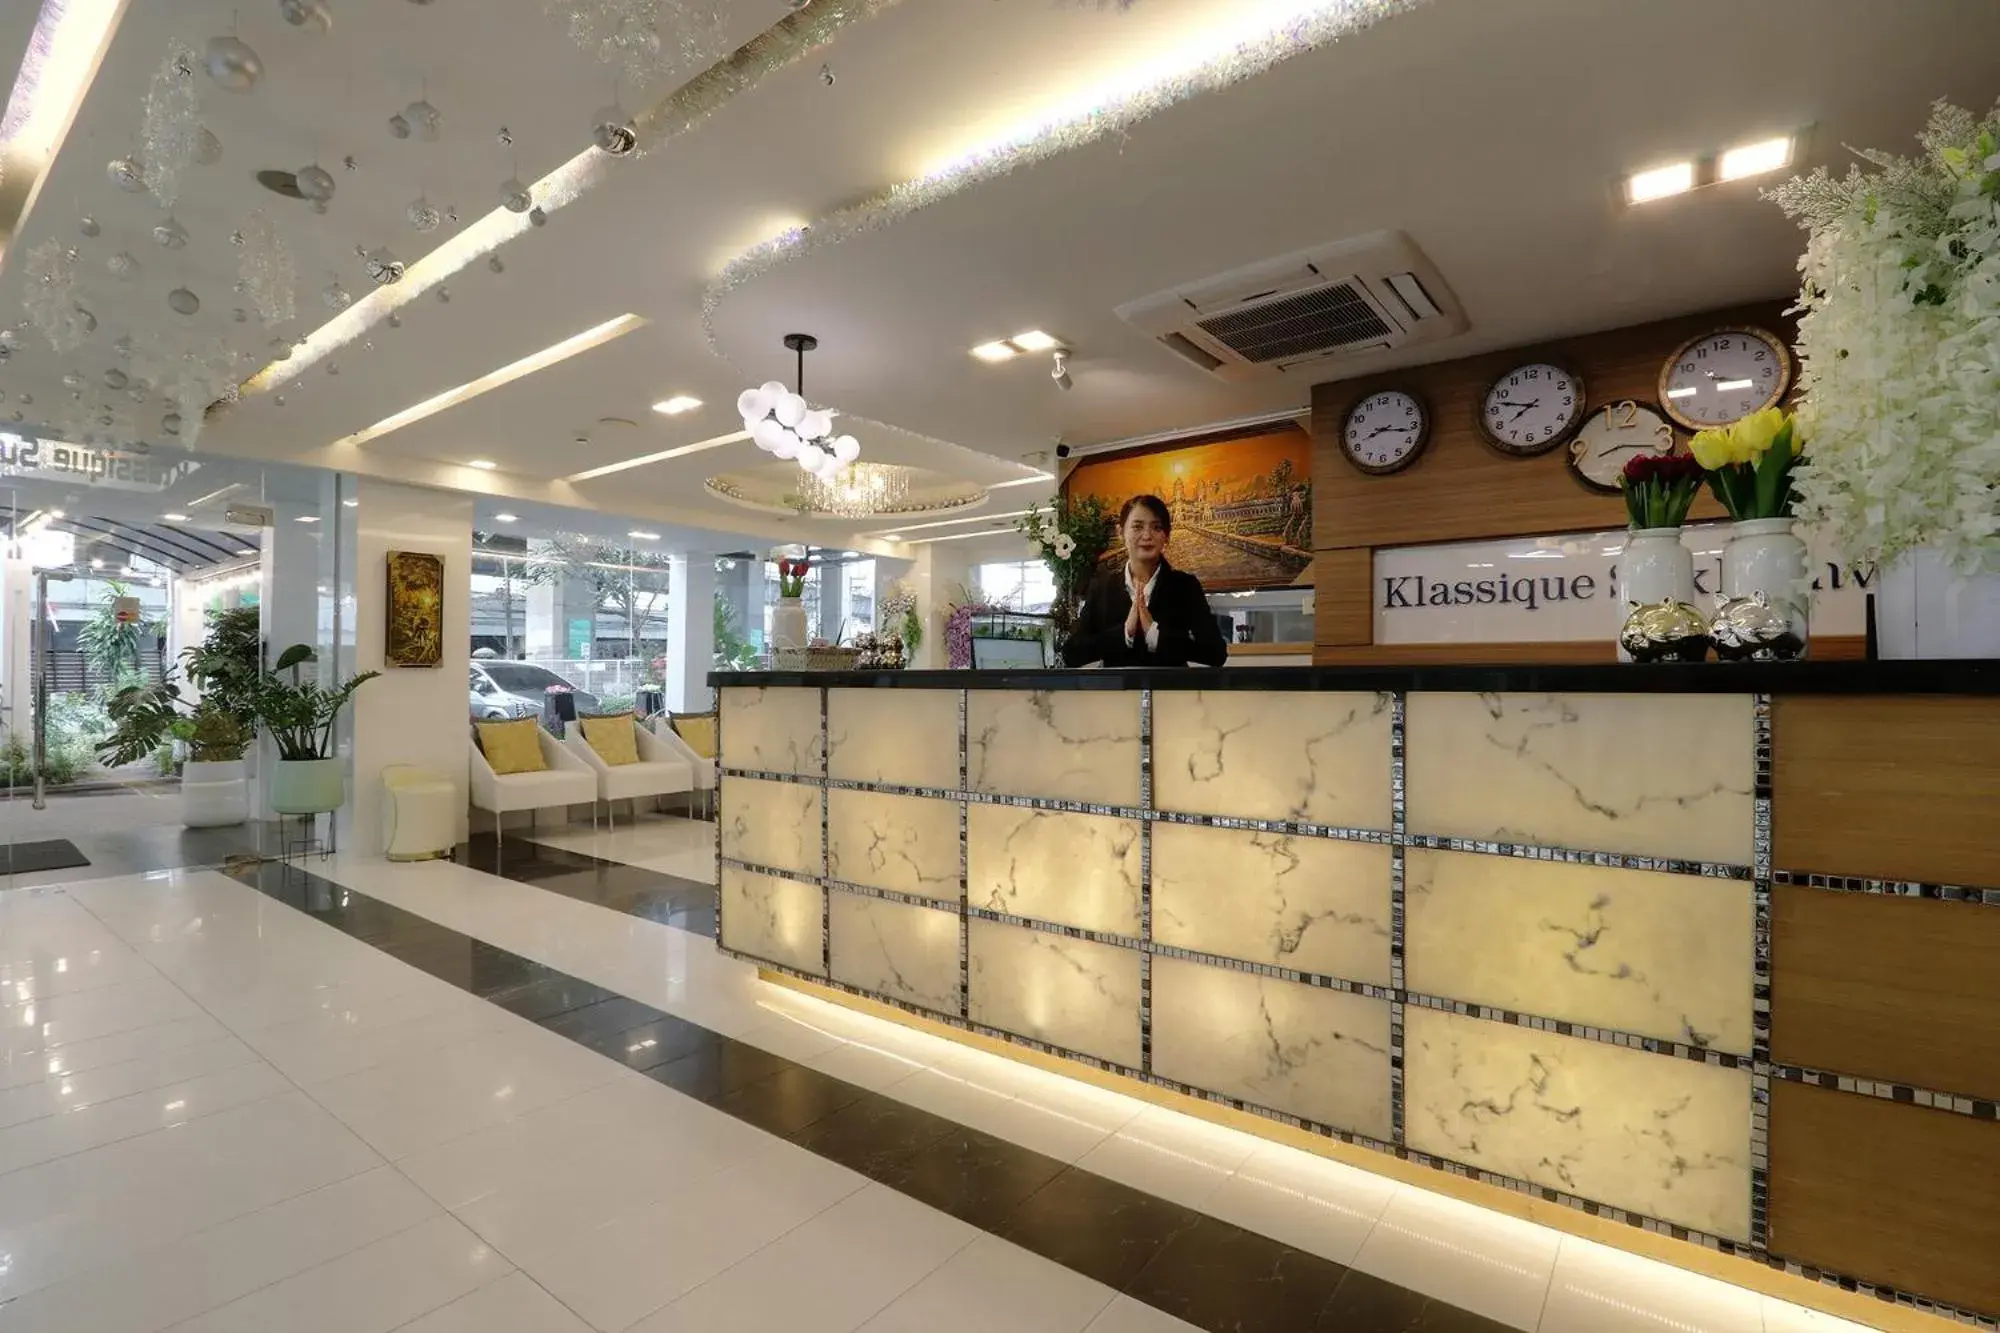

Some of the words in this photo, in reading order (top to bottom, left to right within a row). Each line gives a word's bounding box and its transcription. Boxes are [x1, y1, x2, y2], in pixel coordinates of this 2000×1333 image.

[1713, 340, 1730, 351] 12
[1742, 342, 1748, 351] 1
[1697, 348, 1707, 358] 11
[1754, 351, 1765, 361] 2
[1681, 363, 1695, 373] 10
[1762, 367, 1772, 377] 3
[1524, 369, 1538, 379] 12
[1510, 376, 1519, 386] 11
[1557, 381, 1566, 390] 2
[1496, 389, 1509, 398] 10
[1377, 396, 1390, 405] 12
[1562, 396, 1572, 405] 3
[1366, 403, 1373, 411] 11
[1406, 406, 1413, 415] 2
[1490, 406, 1499, 415] 9
[1741, 401, 1750, 411] 5
[1603, 400, 1637, 431] 12
[1699, 407, 1708, 417] 7
[1354, 415, 1365, 423] 10
[1556, 413, 1565, 422] 4
[1410, 421, 1418, 429] 3
[1495, 421, 1504, 430] 8
[1349, 430, 1357, 438] 9
[1510, 430, 1518, 439] 7
[1544, 426, 1553, 435] 5
[1405, 436, 1412, 444] 4
[1526, 433, 1534, 442] 6
[1654, 423, 1674, 451] 3
[1354, 443, 1361, 452] 8
[1395, 448, 1402, 456] 5
[1366, 452, 1373, 460] 7
[1570, 439, 1589, 466] 9
[1380, 454, 1387, 463] 6
[1383, 573, 1596, 610] Klassique
